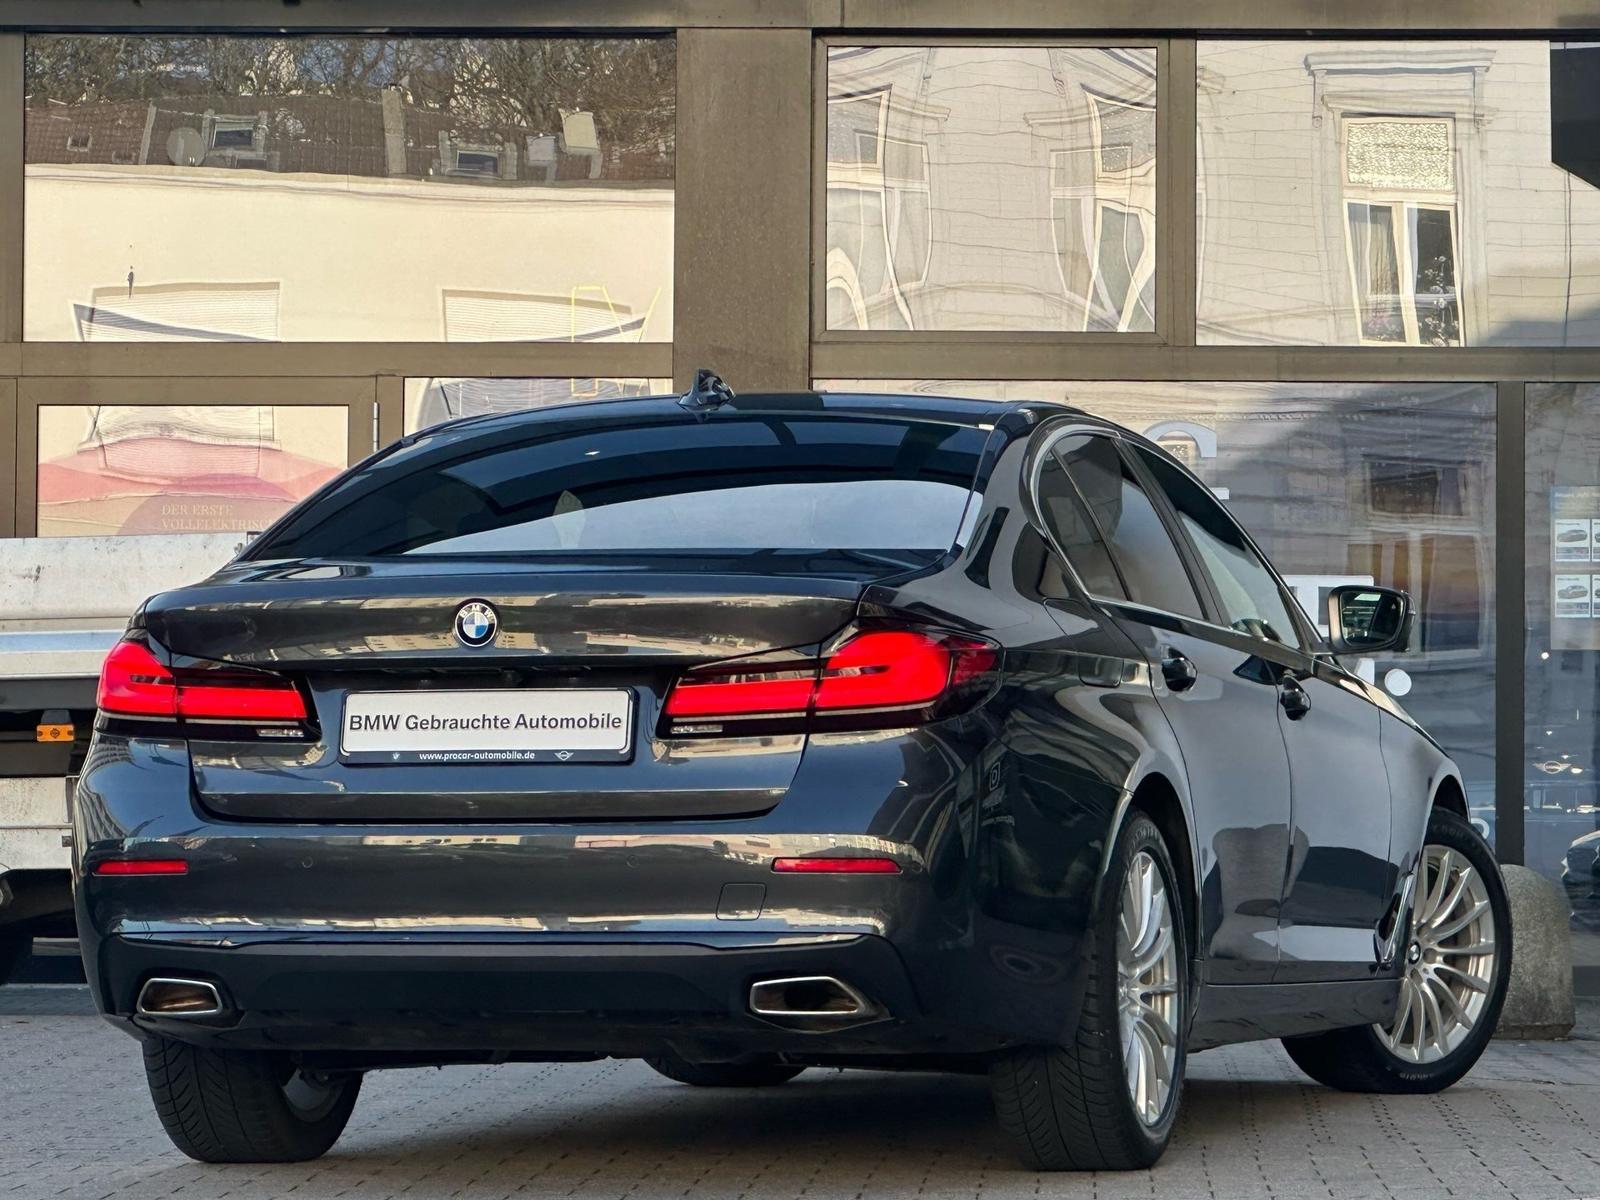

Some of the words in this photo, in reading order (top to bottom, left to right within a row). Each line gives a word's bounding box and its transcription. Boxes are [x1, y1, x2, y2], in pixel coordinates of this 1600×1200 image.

[161, 504, 188, 515] DER
[193, 504, 233, 516] ERSTE
[161, 518, 273, 530] VOLLELEKTRISC
[459, 604, 494, 621] BMW
[349, 714, 400, 731] BMW
[405, 713, 511, 731] Gebrauchte
[514, 713, 622, 730] Automobile
[419, 751, 535, 761] www.procar-automobile.de
